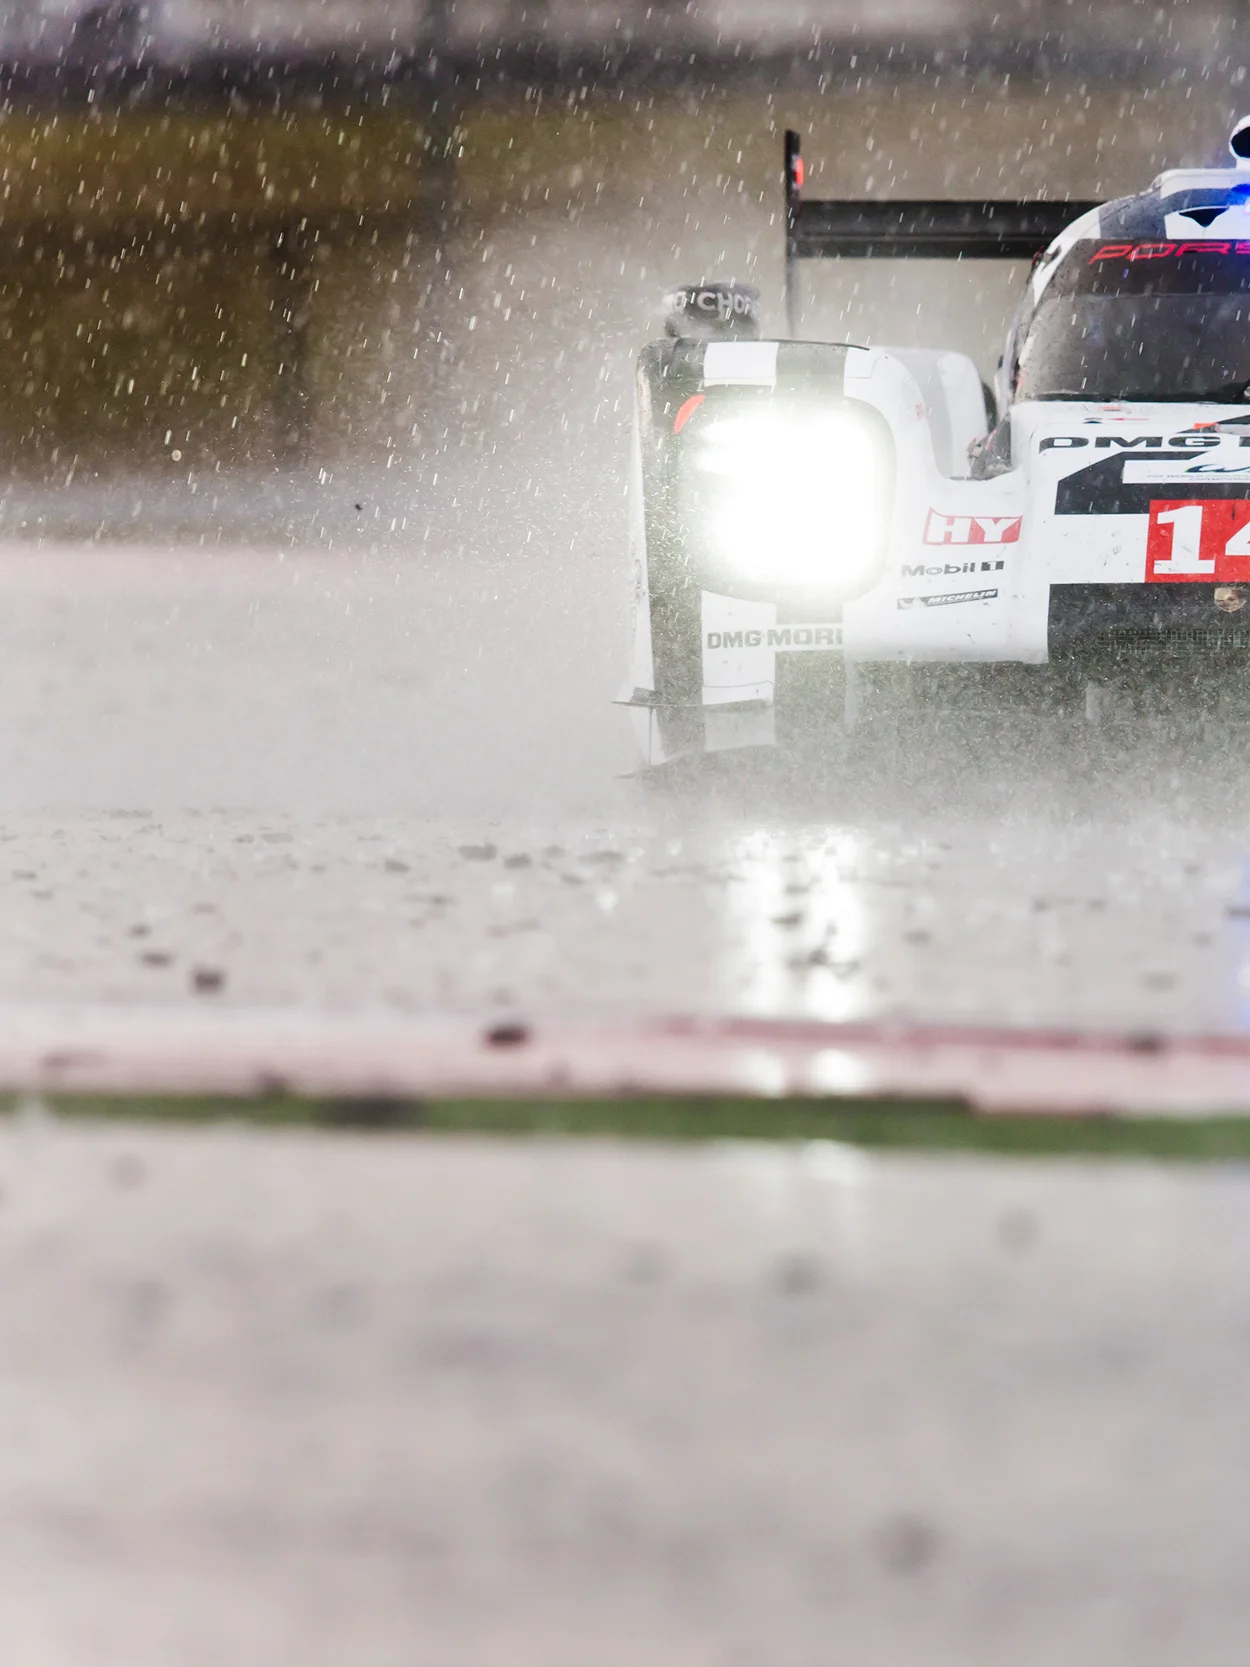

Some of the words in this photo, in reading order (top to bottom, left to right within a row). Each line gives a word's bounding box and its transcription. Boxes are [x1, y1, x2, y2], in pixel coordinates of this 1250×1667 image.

[1039, 435, 1221, 454] DMG
[926, 513, 1020, 544] HY
[902, 562, 976, 577] Mobil
[928, 589, 998, 605] MICHELIN
[707, 630, 763, 649] DMG
[767, 628, 843, 647] MORI
